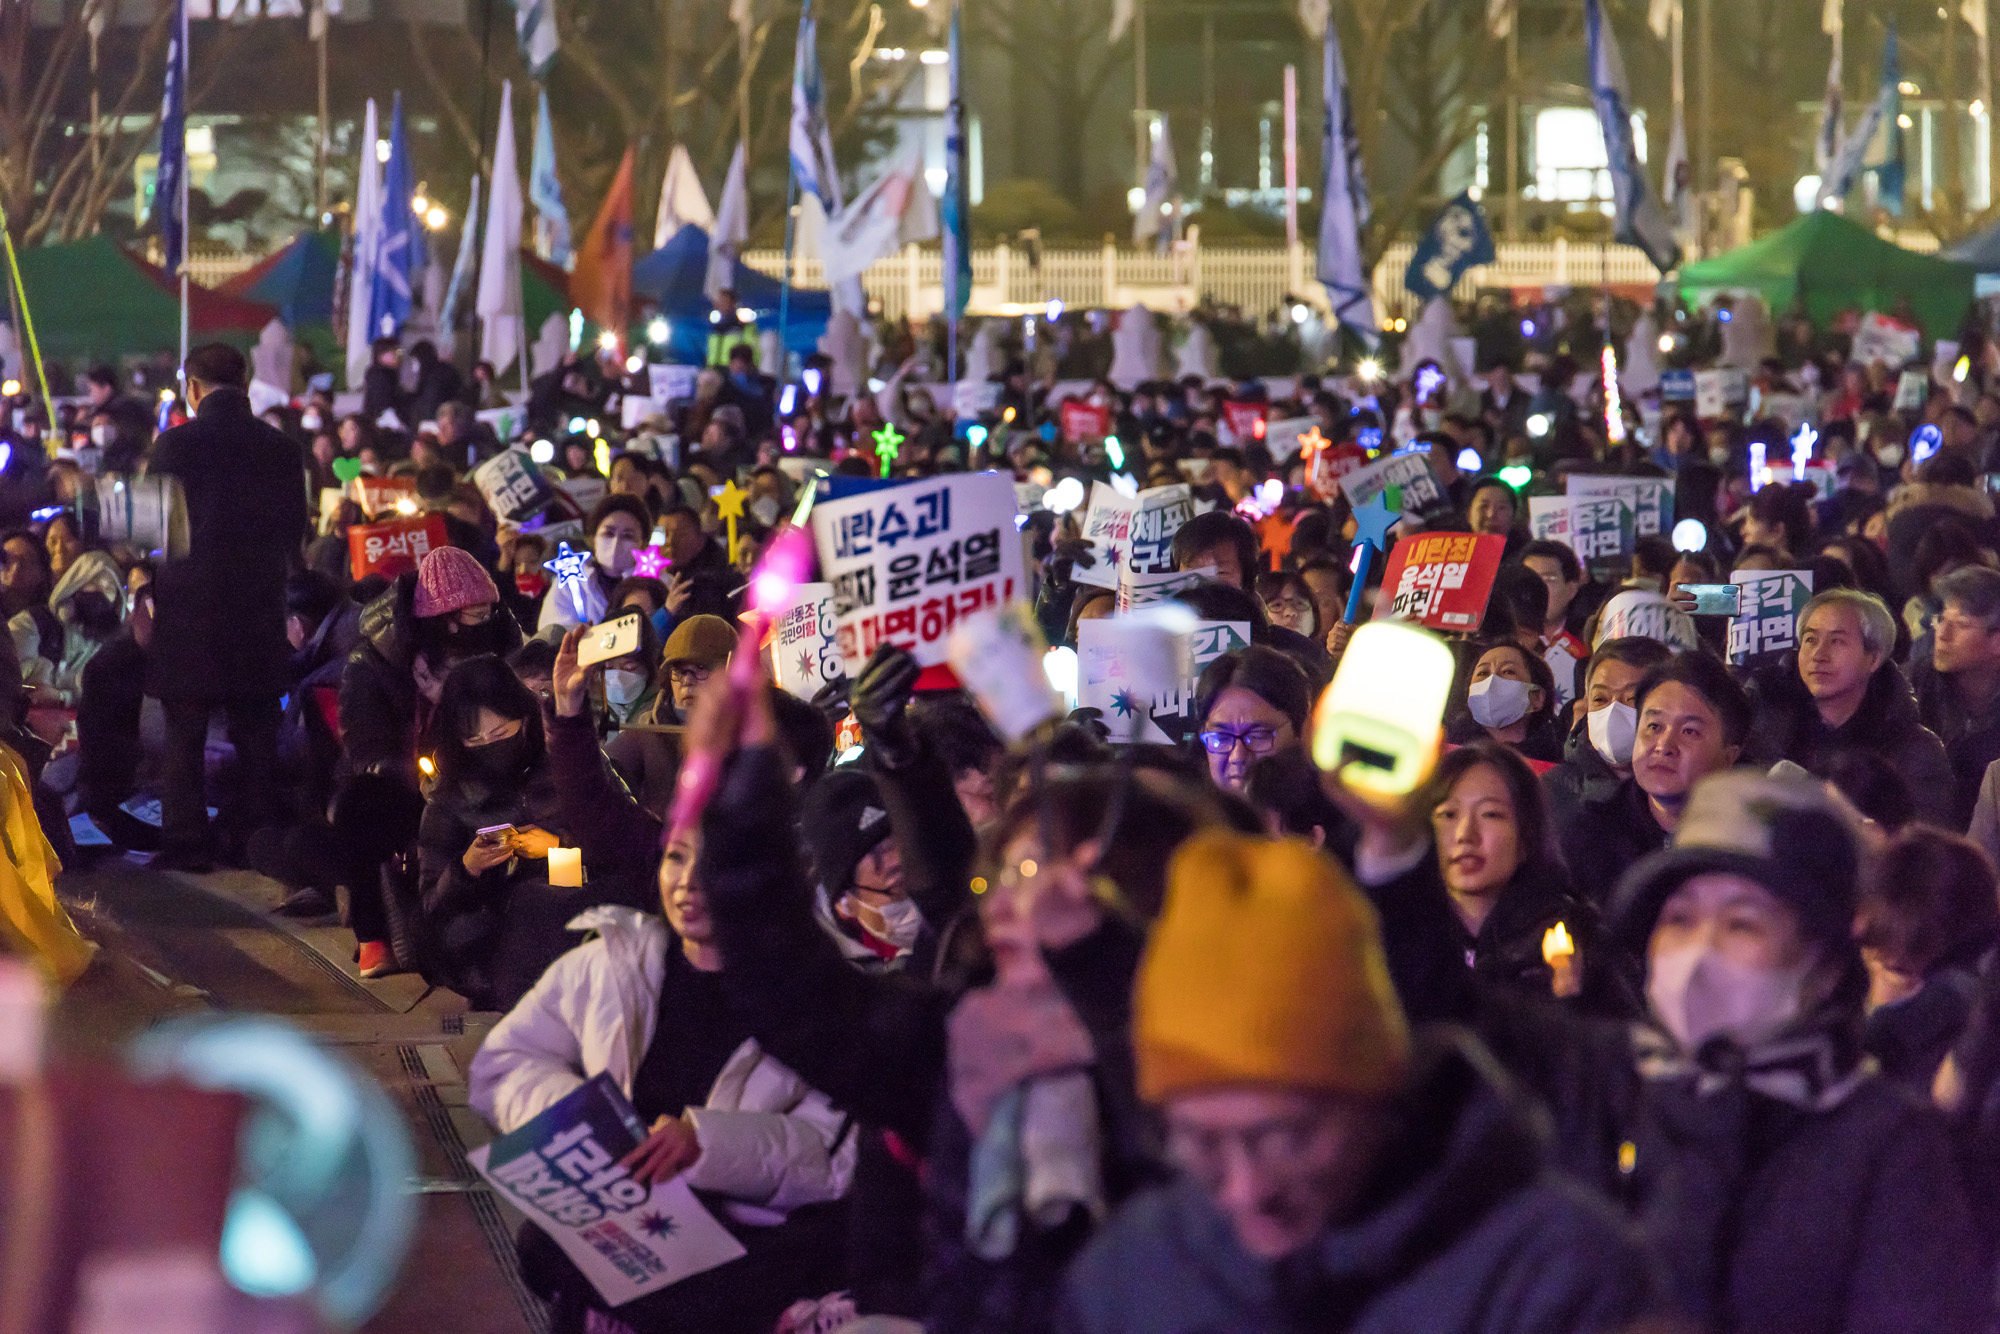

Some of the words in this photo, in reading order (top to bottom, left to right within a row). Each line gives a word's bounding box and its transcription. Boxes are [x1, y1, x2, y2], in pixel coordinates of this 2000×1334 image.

[831, 487, 951, 559] 내란수괴
[887, 527, 1001, 601] 윤석열
[1404, 536, 1478, 567] 내란죄
[1740, 576, 1797, 617] 즉각
[780, 619, 817, 647] 국민의힘
[1731, 613, 1794, 656] 파면
[541, 1121, 648, 1211] 하라
